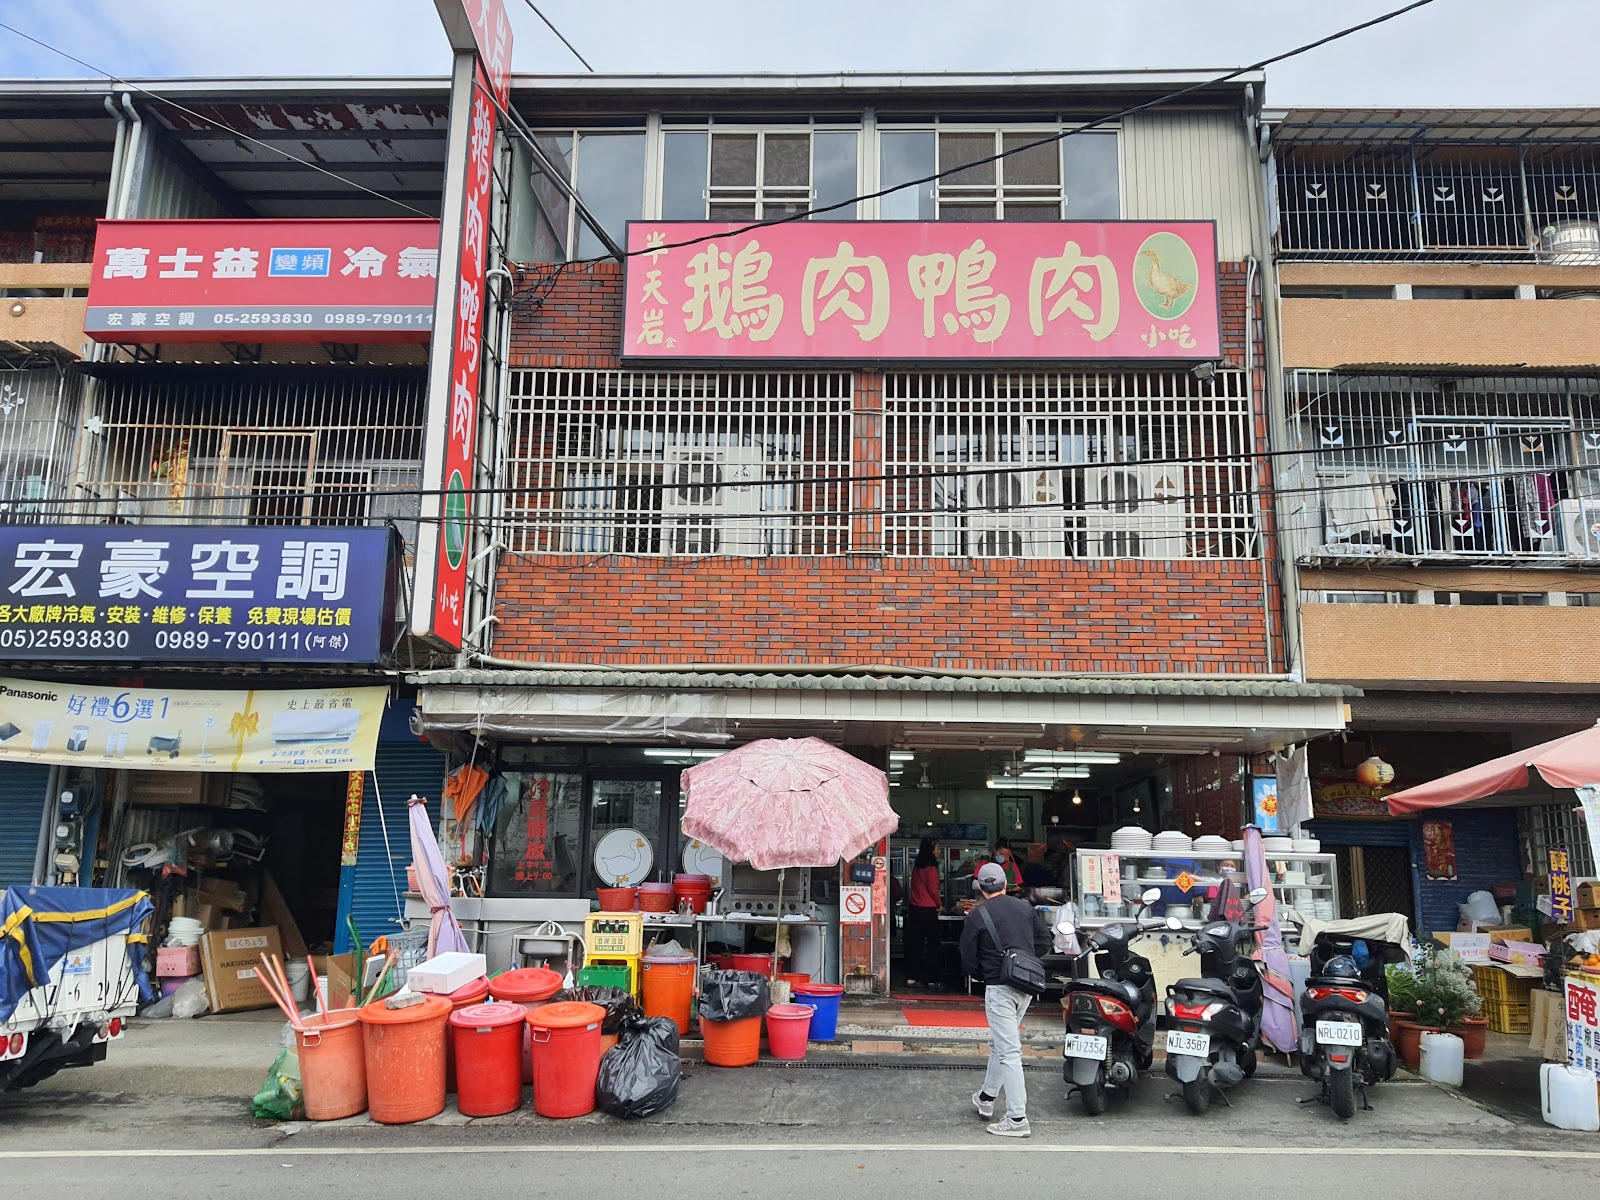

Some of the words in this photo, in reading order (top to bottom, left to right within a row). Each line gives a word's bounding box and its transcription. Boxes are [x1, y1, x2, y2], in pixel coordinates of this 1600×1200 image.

[102, 247, 259, 279] 萬士益
[274, 252, 326, 272] 變頻
[340, 246, 439, 279] 冷氣
[683, 238, 1121, 343] 鵝肉鴨肉
[106, 312, 195, 327] 宏豪空調
[213, 313, 313, 325] 05-2593830
[324, 313, 434, 325] 0989-790111
[1140, 323, 1198, 349] 小吃
[7, 538, 350, 601] 宏豪空調
[247, 607, 352, 626] 免費現場估價
[439, 583, 459, 627] 小吃
[0, 685, 58, 702] Panasonic
[65, 692, 170, 721] 好禮6選1
[287, 697, 353, 711] 史上最省電
[1549, 850, 1573, 917] 醃桃子
[229, 937, 264, 948] はくちょう
[1567, 983, 1599, 1028] 醃
